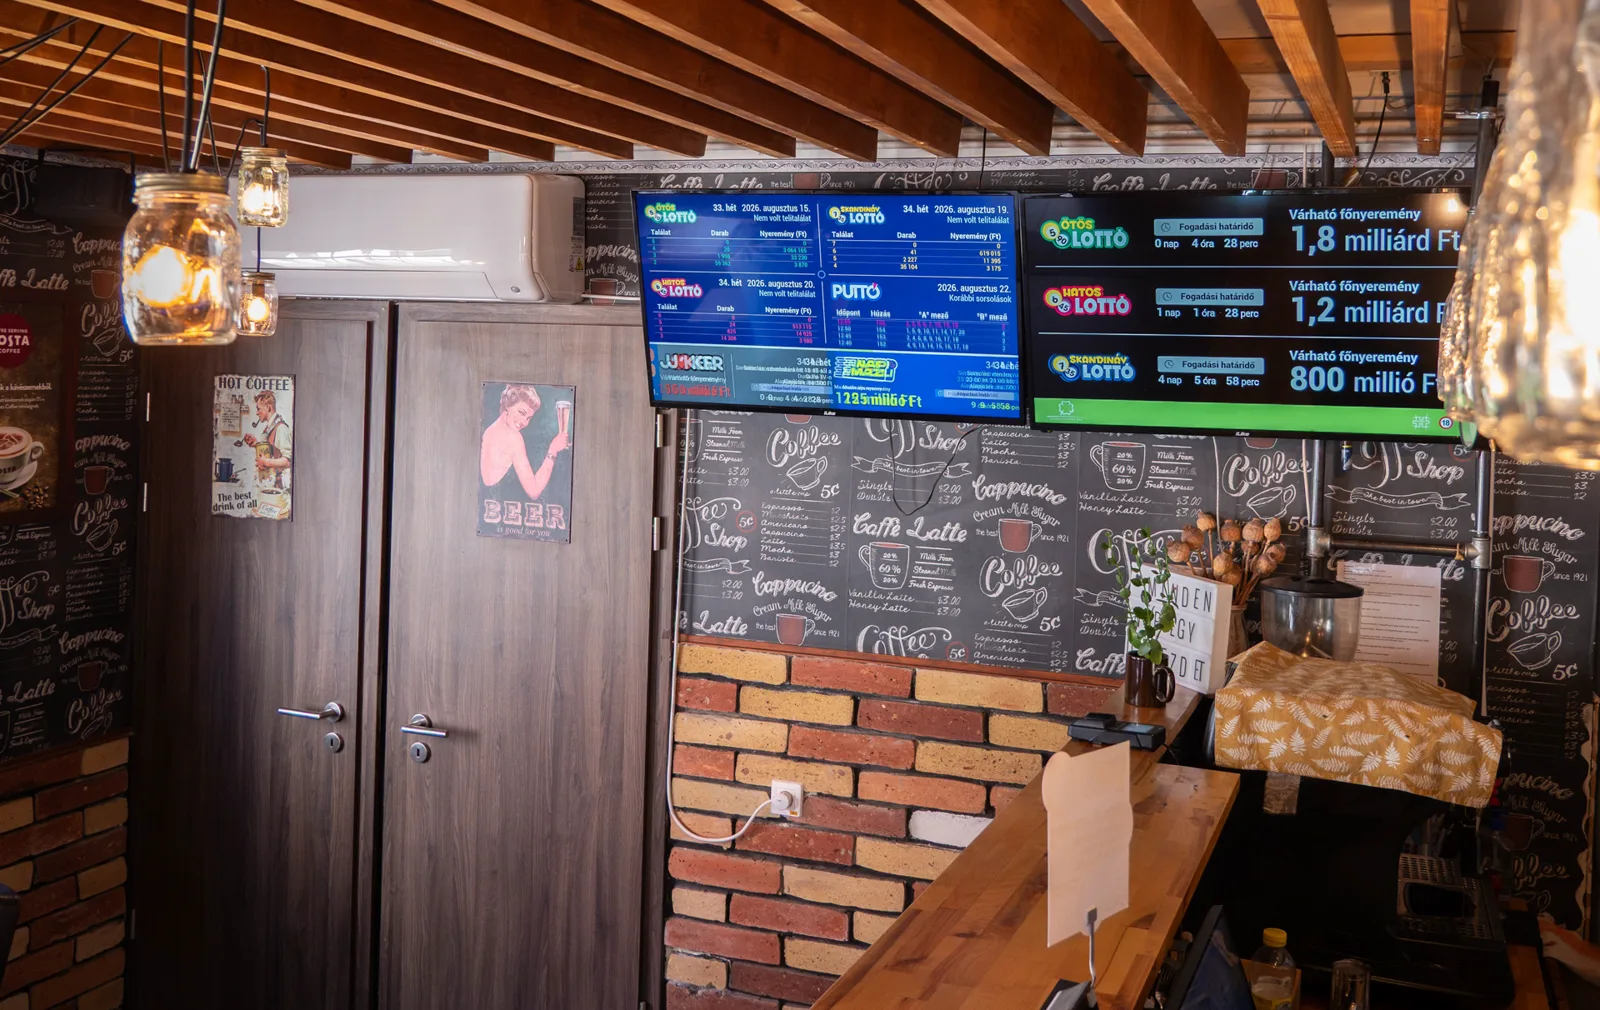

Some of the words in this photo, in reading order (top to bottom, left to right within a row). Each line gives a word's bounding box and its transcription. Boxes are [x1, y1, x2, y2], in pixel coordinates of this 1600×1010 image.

[656, 202, 676, 212] ÖTÖS
[712, 204, 724, 212] 33.
[726, 204, 737, 212] hét
[742, 204, 762, 212] 2026.
[762, 205, 798, 214] augusztus
[799, 204, 810, 212] 15.
[840, 204, 880, 213] SKANDINÁV
[902, 205, 915, 213] 34.
[916, 204, 928, 213] hét
[934, 206, 955, 214] 2026.
[957, 206, 995, 215] augusztus
[997, 206, 1009, 214] 19.
[663, 210, 696, 224] LOTTÓ
[754, 214, 768, 222] Nem
[769, 214, 781, 222] volt
[782, 214, 812, 222] telitalálat
[850, 211, 885, 224] LOTTÓ
[946, 216, 962, 224] Nem
[963, 216, 977, 224] volt
[978, 216, 1010, 224] telitalálat
[1288, 208, 1337, 220] Várható
[1340, 208, 1420, 222] főnyeremény
[1060, 216, 1093, 230] ÖTÖS
[1179, 222, 1218, 232] Fogadási
[1220, 222, 1254, 231] határidő
[760, 230, 794, 238] Nyeremény
[950, 232, 988, 241] Nyeremény
[1049, 228, 1056, 237] 5
[1056, 234, 1068, 245] 90
[1072, 227, 1129, 248] LOTTÓ
[1154, 238, 1162, 248] 0
[1164, 240, 1180, 249] nap
[1192, 238, 1199, 248] 4
[1200, 239, 1214, 248] óra
[1224, 238, 1238, 248] 28
[1240, 240, 1258, 250] perc
[1292, 224, 1336, 256] 1,8
[1344, 228, 1430, 252] milliárd
[1438, 229, 1460, 252] Ft
[20, 268, 69, 290] Latte
[731, 279, 742, 287] hét
[768, 280, 802, 289] augusztus
[804, 281, 816, 289] 20.
[669, 284, 702, 297] LOTTÓ
[774, 290, 786, 298] volt
[786, 290, 816, 298] telitalálat
[832, 282, 880, 300] PUTTÓ
[938, 284, 959, 292] 2026.
[960, 285, 998, 294] augusztus
[999, 285, 1012, 293] 22.
[1062, 288, 1102, 297] HATOS
[1288, 280, 1337, 292] Várható
[1339, 280, 1420, 294] főnyeremény
[949, 294, 975, 302] Korábbi
[976, 295, 1012, 303] sorsolások
[1074, 294, 1130, 314] LOTTÓ
[1180, 292, 1218, 302] Fogadási
[1220, 292, 1254, 301] határidő
[765, 306, 799, 315] Nyeremény
[1156, 308, 1162, 317] 1
[1164, 309, 1181, 319] nap
[1193, 308, 1198, 317] 1
[1202, 308, 1216, 318] óra
[1225, 308, 1238, 318] 28
[1240, 310, 1259, 319] perc
[1292, 296, 1336, 327] 1,2
[1344, 300, 1429, 324] milliárd
[0, 334, 30, 347] OSTA
[1069, 352, 1127, 364] SKANDINÁV
[1182, 360, 1219, 370] Fogadási
[1220, 360, 1255, 370] határidő
[1288, 350, 1336, 362] Várható
[1338, 350, 1419, 366] főnyeremény
[1082, 362, 1135, 380] LOTTÓ
[218, 376, 242, 389] HOT
[246, 377, 290, 390] COFFEE
[1158, 376, 1165, 385] 4
[1166, 377, 1182, 386] nap
[1194, 376, 1201, 385] 5
[1202, 376, 1217, 386] óra
[1226, 376, 1240, 386] 58
[1241, 378, 1260, 387] perc
[1290, 365, 1345, 392] 800
[1354, 370, 1416, 393] millió
[1442, 419, 1450, 427] 18
[766, 425, 842, 468] Coffee
[1222, 450, 1312, 497] Coffee
[1406, 450, 1464, 485] Shop
[217, 494, 232, 502] The
[234, 492, 252, 500] best
[820, 484, 840, 499] 5¢
[972, 474, 1068, 506] Cappucino
[1078, 490, 1120, 502] Vanilla
[1120, 493, 1152, 504] Latte
[212, 502, 234, 512] drink
[236, 500, 245, 509] of
[247, 500, 258, 508] all
[972, 504, 1005, 522] Cream
[70, 494, 128, 536] Coffee
[484, 500, 566, 530] BEER
[1332, 510, 1376, 526] Single
[1430, 516, 1458, 527] $2.00
[504, 526, 523, 535] good
[524, 528, 535, 537] for
[536, 530, 550, 538] you
[906, 516, 968, 543] Latte
[704, 522, 748, 552] Shop
[1542, 540, 1578, 564] Sugar
[979, 554, 1063, 598] Coffee
[1552, 572, 1570, 581] since
[1572, 572, 1588, 582] 1921
[752, 570, 838, 602] Cappucino
[17, 596, 56, 621] Shop
[848, 600, 880, 613] Honey
[881, 602, 911, 613] Latte
[692, 610, 748, 636] Latte
[1039, 616, 1061, 632] 5¢
[1487, 594, 1580, 642] Coffee
[814, 629, 826, 637] since
[1552, 663, 1578, 681] 5¢
[65, 688, 124, 734] Coffee
